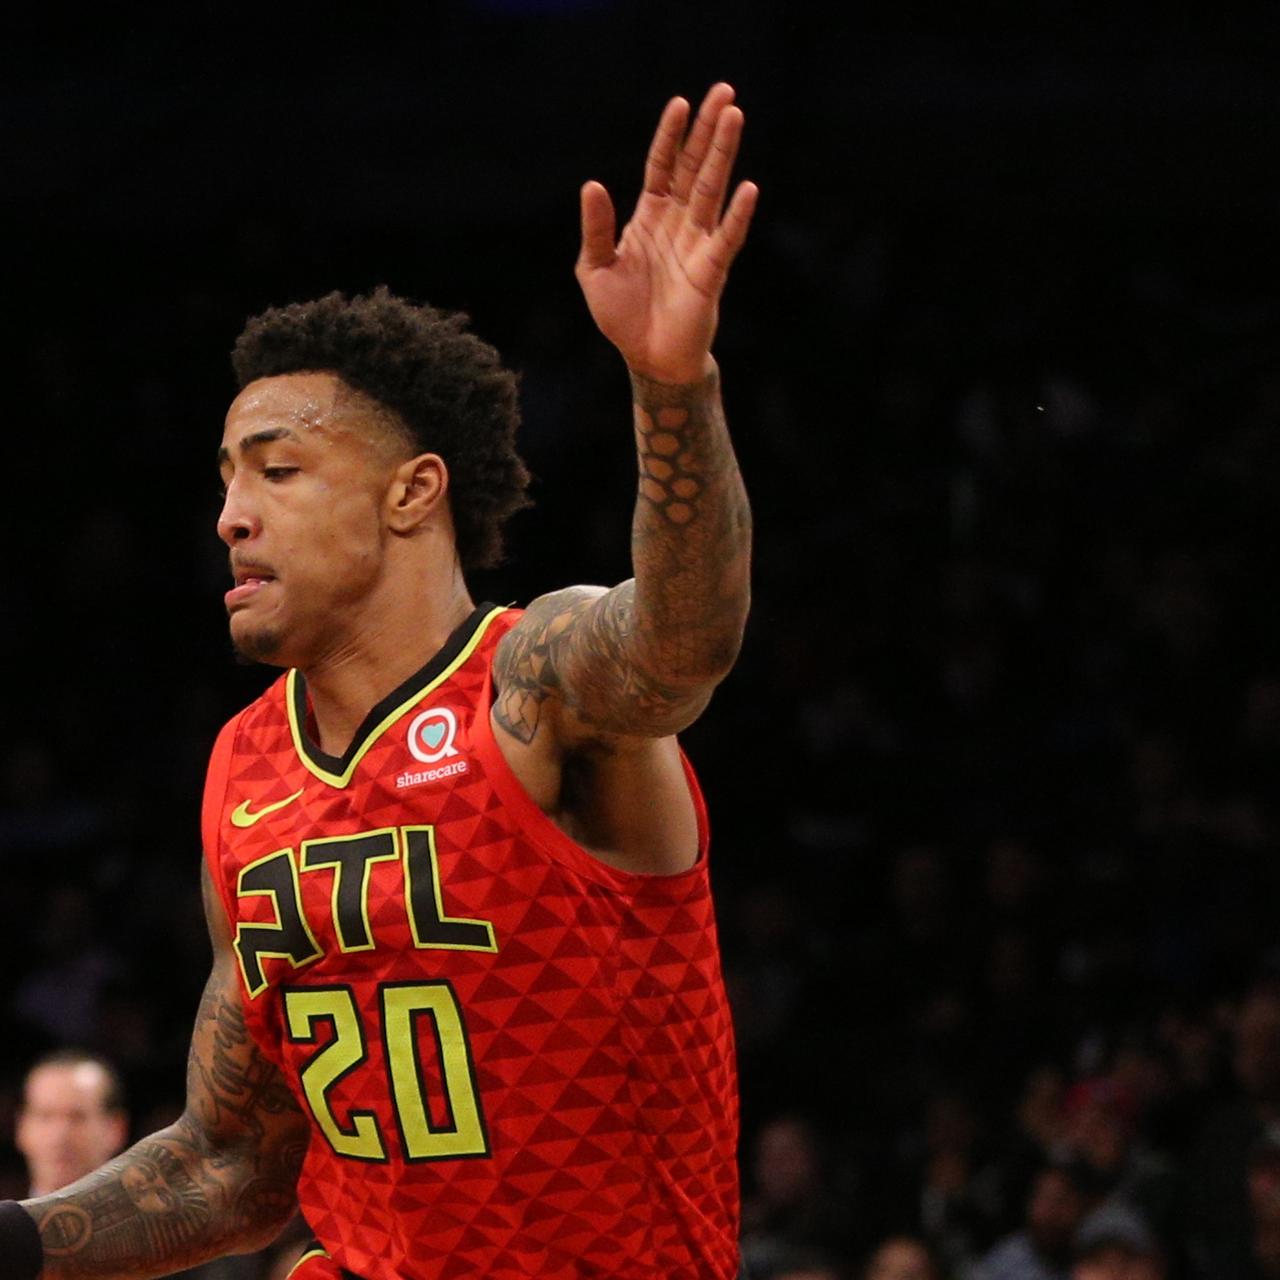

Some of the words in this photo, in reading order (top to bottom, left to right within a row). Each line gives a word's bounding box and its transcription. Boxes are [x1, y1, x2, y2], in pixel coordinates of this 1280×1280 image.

[396, 760, 467, 789] sharecare
[232, 823, 499, 1000] ATL
[281, 980, 492, 1164] 20
